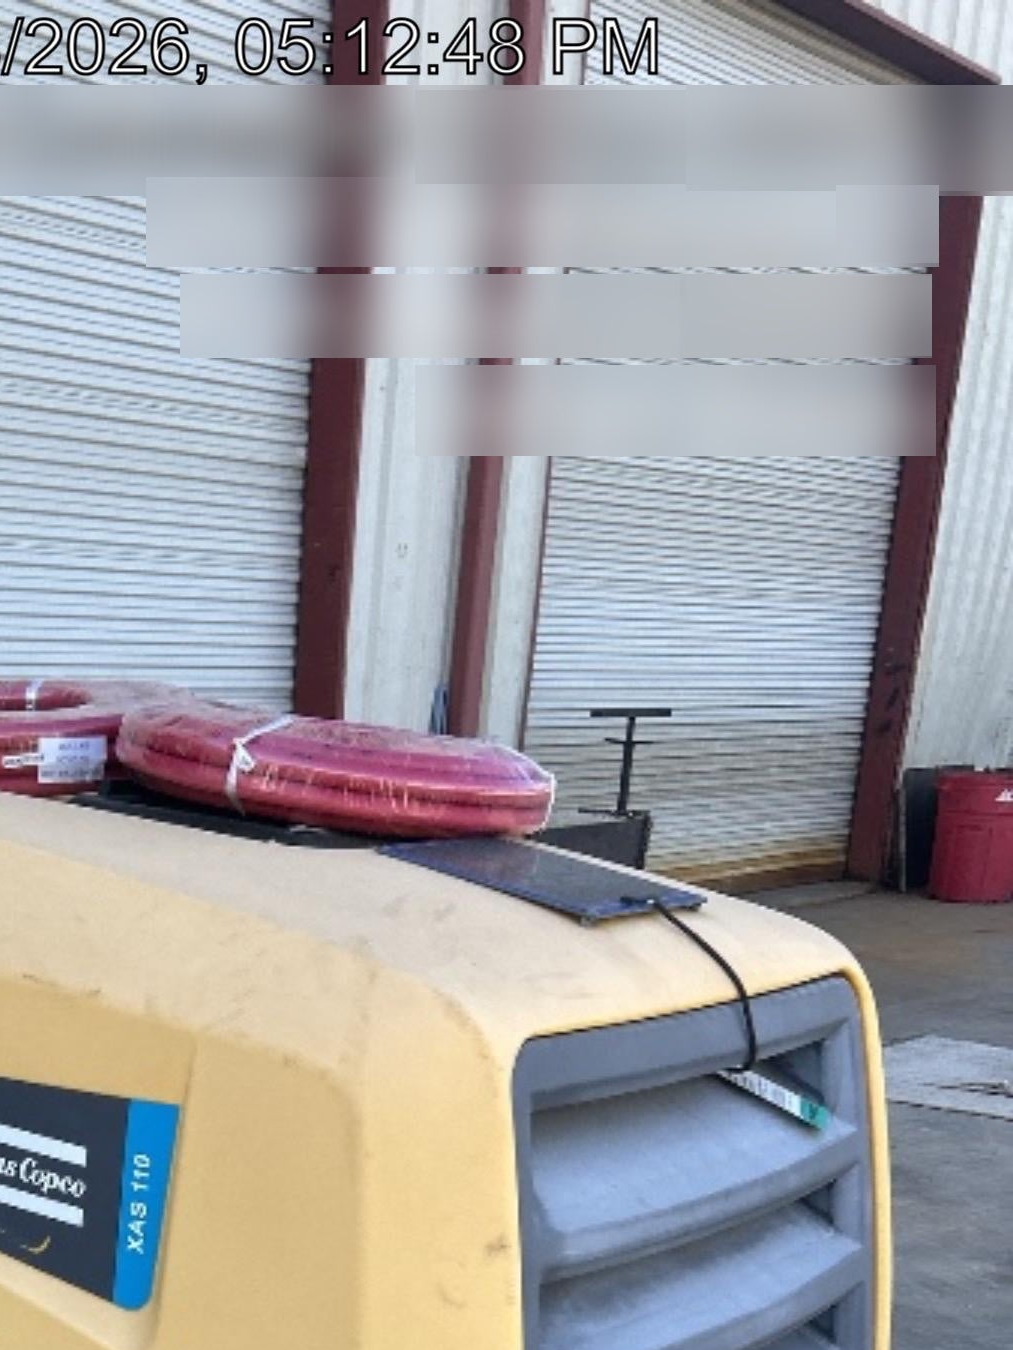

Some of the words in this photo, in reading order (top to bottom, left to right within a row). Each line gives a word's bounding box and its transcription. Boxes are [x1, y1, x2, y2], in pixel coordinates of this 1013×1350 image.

[19, 1157, 86, 1198] Copco
[130, 1154, 150, 1192] 110
[127, 1202, 147, 1254] XAS
